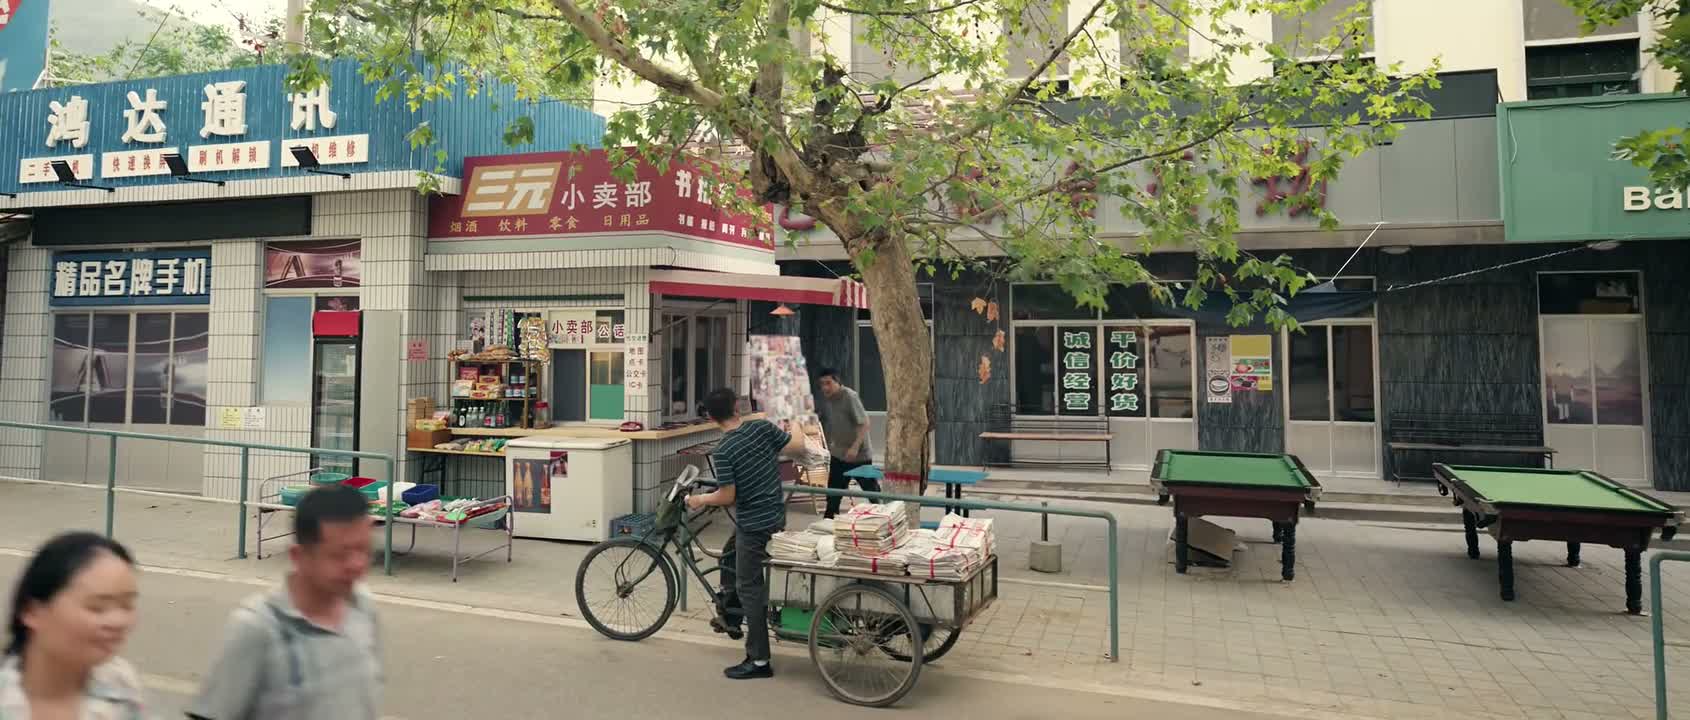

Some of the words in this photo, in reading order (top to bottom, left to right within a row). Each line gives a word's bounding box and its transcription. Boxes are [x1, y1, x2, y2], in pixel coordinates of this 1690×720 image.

[46, 80, 337, 148] 鸿达通讯
[199, 146, 257, 166] 刷机解锁
[311, 140, 356, 159] 机维修
[28, 161, 80, 177] 二手机
[467, 167, 556, 212] 三元
[561, 180, 652, 210] 小卖部
[1623, 186, 1690, 211] Ba
[450, 220, 478, 234] 烟酒
[498, 218, 529, 232] 饮料
[549, 216, 580, 232] 零食
[603, 214, 650, 227] 日用品
[54, 257, 207, 297] 精品名牌手机
[551, 319, 593, 334] 小卖部
[1063, 331, 1091, 411] 诚信经营
[1110, 330, 1139, 412] 平价好货
